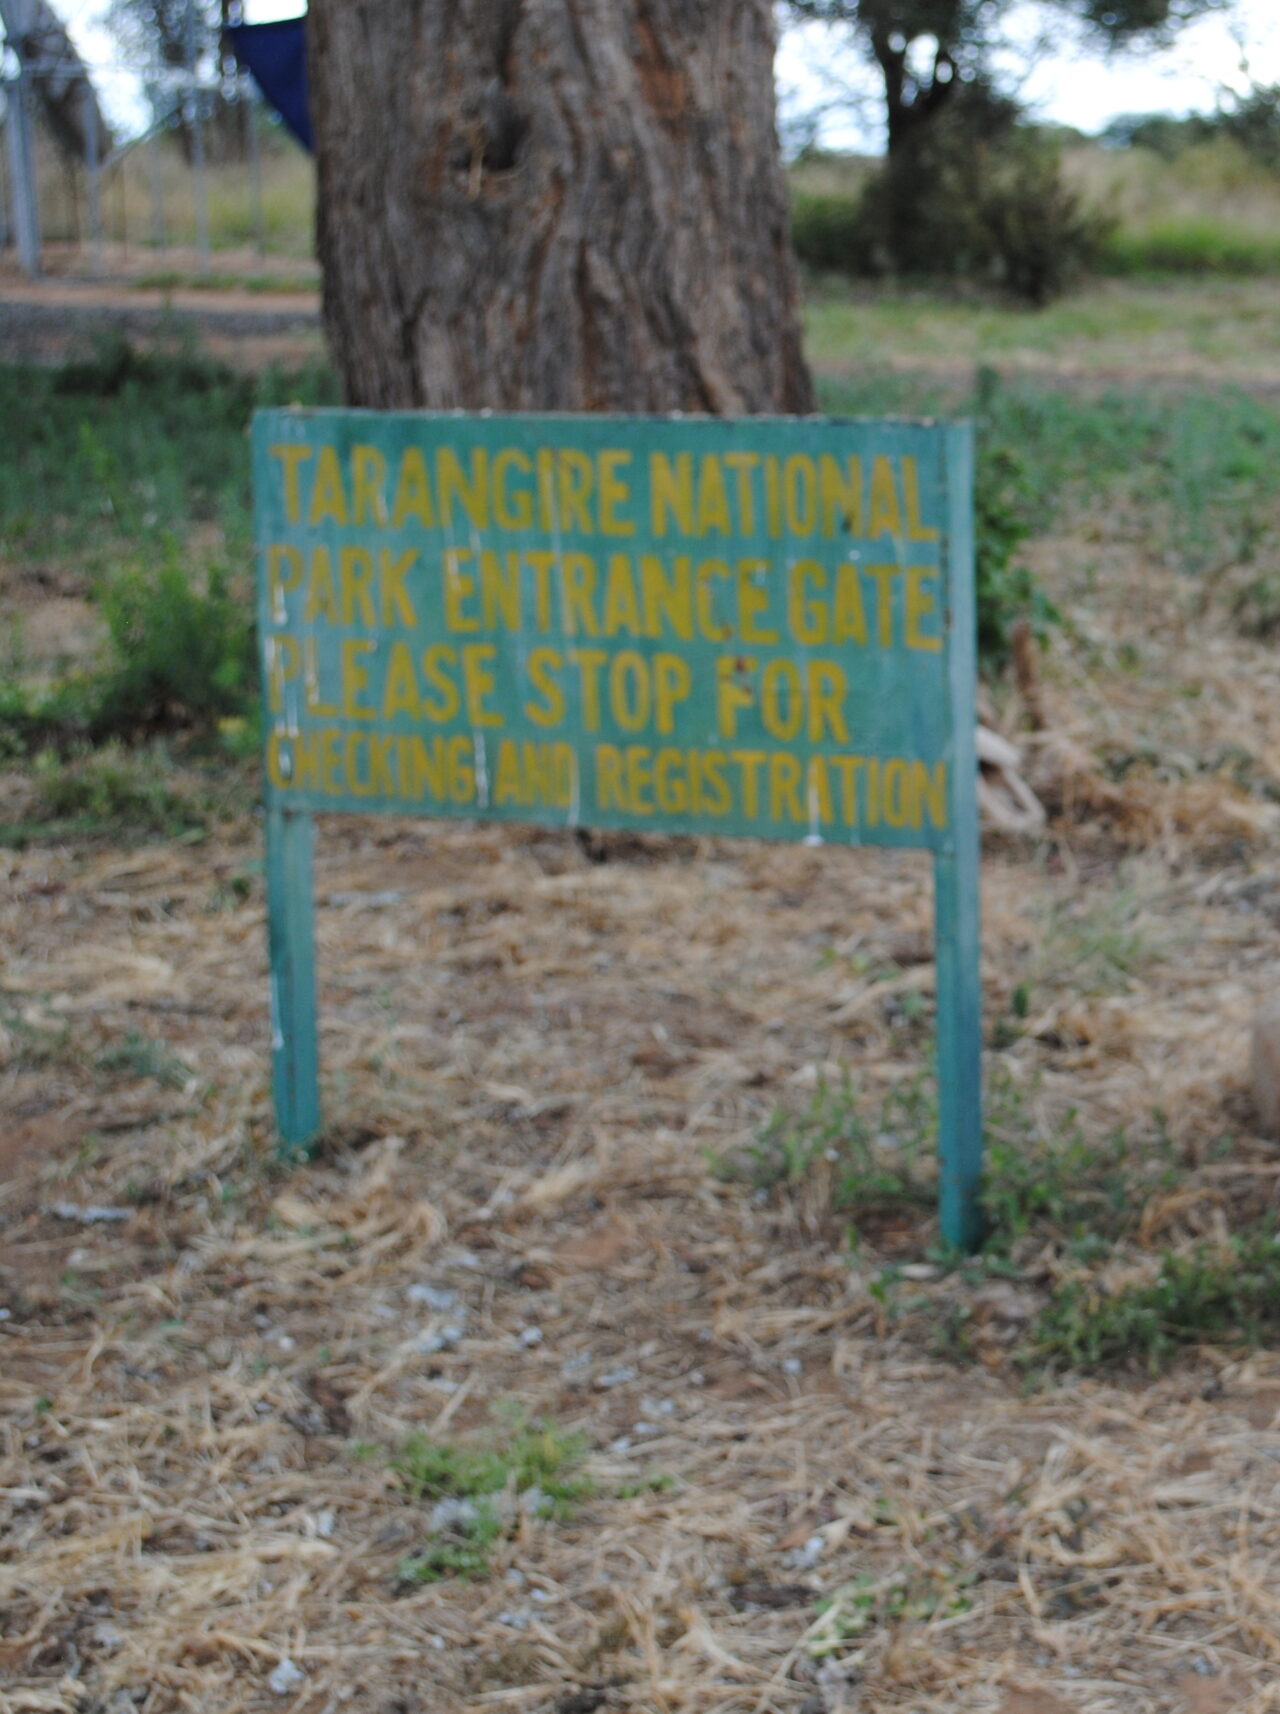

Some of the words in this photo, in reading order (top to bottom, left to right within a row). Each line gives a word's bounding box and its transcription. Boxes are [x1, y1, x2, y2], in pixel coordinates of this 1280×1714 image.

[269, 443, 635, 537] TARANGIRE
[649, 450, 938, 542] NATIONAL
[267, 543, 419, 628] PARK
[444, 548, 781, 644] ENTRANCE
[788, 560, 945, 652] GATE
[267, 637, 504, 728] PLEASE
[525, 647, 692, 735] STOP
[716, 656, 850, 744] FOR
[267, 730, 475, 804] CHECKING
[495, 741, 578, 808] AND
[596, 745, 947, 829] REGISTRATION
